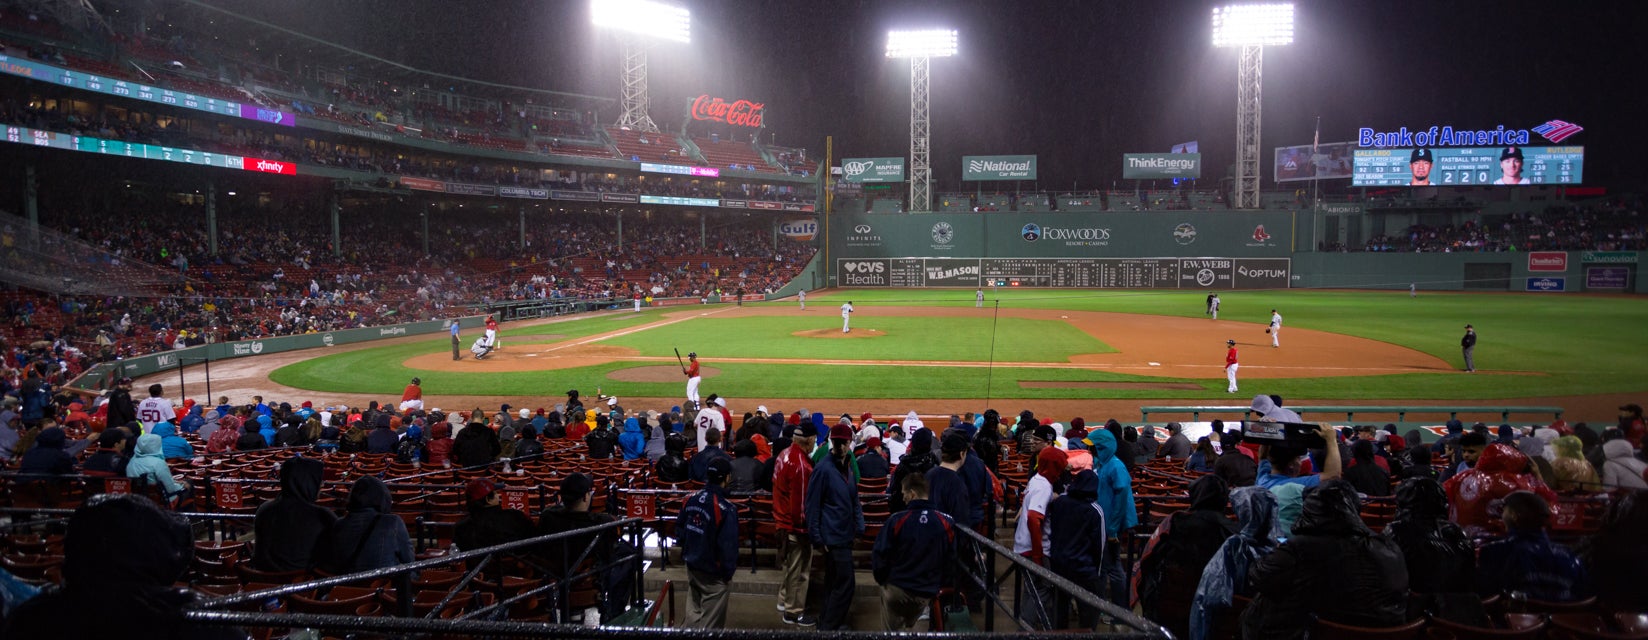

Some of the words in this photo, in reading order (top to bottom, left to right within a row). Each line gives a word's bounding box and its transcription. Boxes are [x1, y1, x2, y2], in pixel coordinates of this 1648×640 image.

[33, 130, 48, 139] SEA
[1359, 127, 1412, 147] Bank
[1415, 126, 1438, 147] of
[1439, 125, 1529, 145] America
[34, 138, 48, 146] BOS
[257, 160, 283, 173] xfinity
[847, 162, 863, 173] AAA
[983, 161, 1030, 171] National
[1445, 173, 1452, 182] 2
[1462, 173, 1469, 182] 2
[1479, 172, 1487, 182] 0
[781, 223, 815, 234] Gulf
[1042, 227, 1110, 240] FOXWOODS
[857, 262, 885, 273] CVS
[846, 274, 884, 284] Health
[1250, 270, 1286, 278] OPTUM
[142, 410, 160, 422] 50
[700, 416, 713, 428] 21
[909, 426, 917, 434] 5
[222, 494, 239, 503] 33
[507, 503, 525, 511] 32
[633, 506, 648, 516] 31
[1557, 514, 1576, 525] 27
